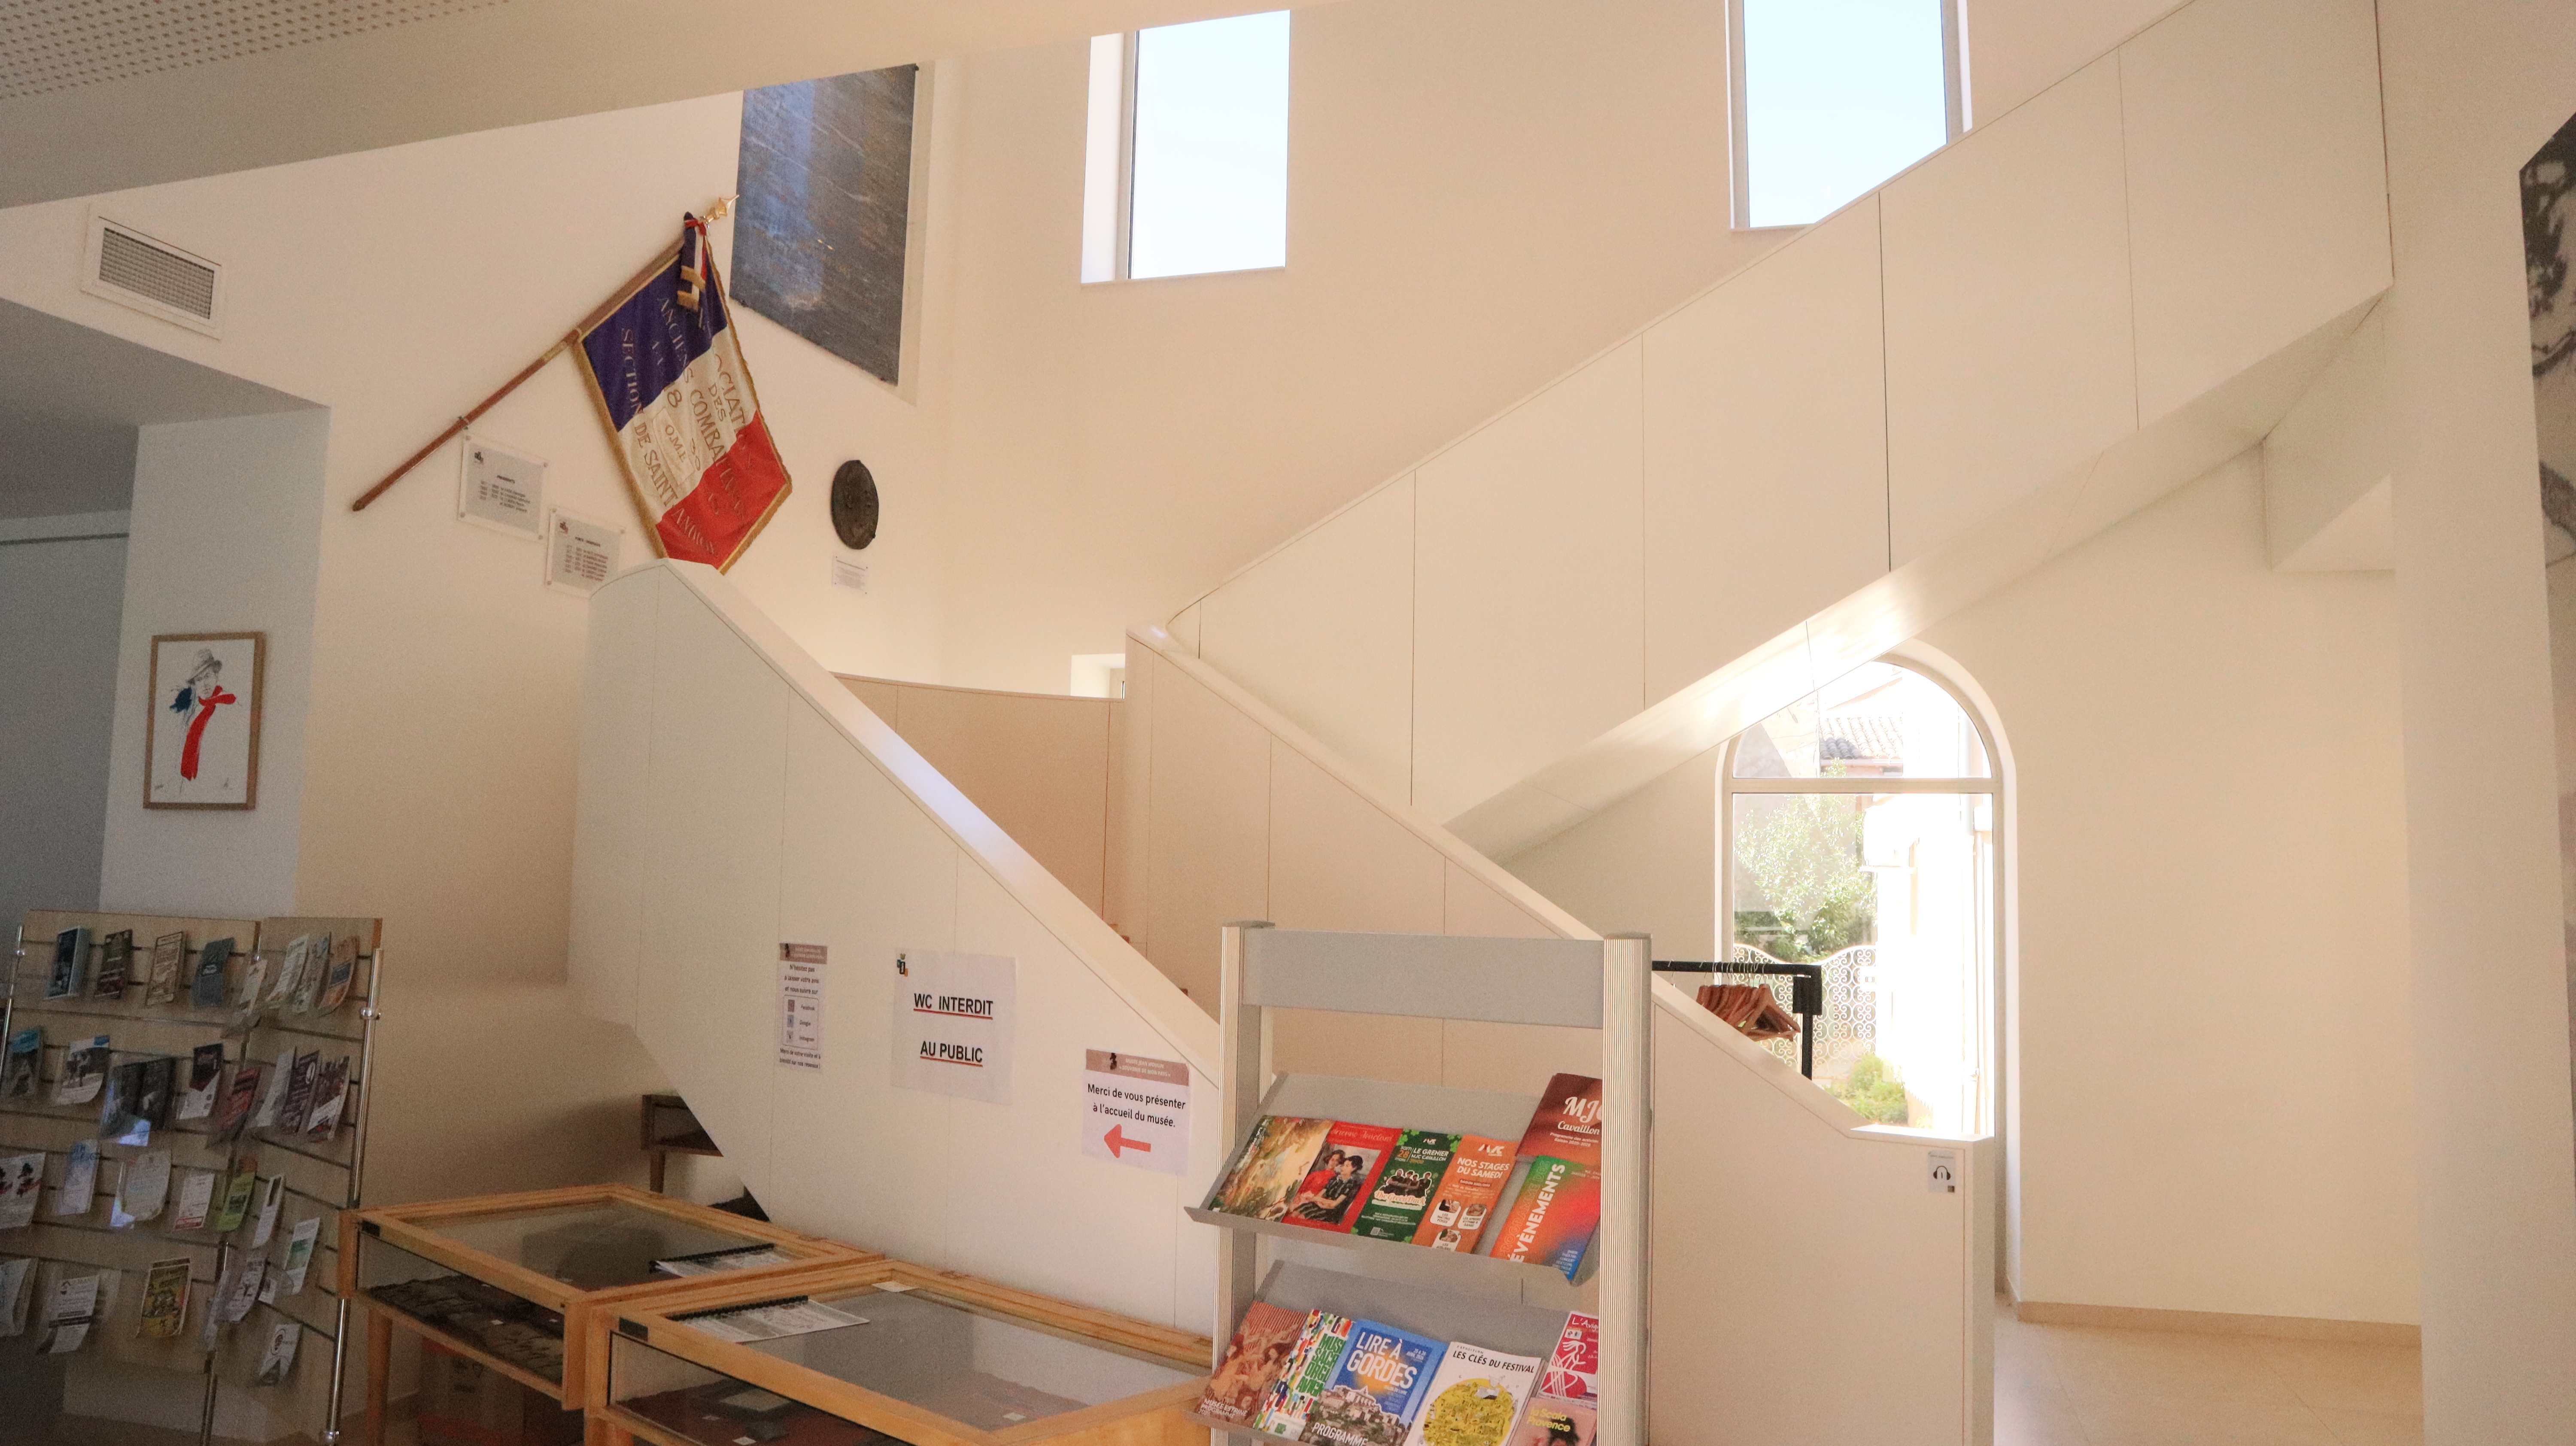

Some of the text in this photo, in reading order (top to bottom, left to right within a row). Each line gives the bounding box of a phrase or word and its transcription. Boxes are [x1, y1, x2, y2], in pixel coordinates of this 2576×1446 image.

[708, 383, 726, 421] DES
[634, 422, 651, 448] DE
[914, 993, 993, 1015] WC INTERDIT
[920, 1041, 983, 1063] AU PUBLIC
[1088, 1083, 1186, 1109] Merci de vous présenter
[1093, 1103, 1097, 1112] à
[1135, 1111, 1145, 1121] du
[1147, 1115, 1176, 1127] musée.
[1558, 1121, 1600, 1135] Cavaillon
[1397, 1150, 1410, 1158] 28
[1457, 1157, 1510, 1171] NOS STAGES
[1457, 1166, 1503, 1179] DU SAMEDI
[1507, 1164, 1566, 1263] ÉVÈNEMENTS
[1356, 1332, 1403, 1360] LIRE À
[1347, 1350, 1417, 1389] GORDES
[1453, 1350, 1534, 1373] LES CLÉS DU FESTIVAL
[1200, 1403, 1236, 1419] PROGRAMME
[1224, 1405, 1248, 1416] ESTRINE
[1540, 1408, 1567, 1422] Scala
[1312, 1422, 1368, 1446] PROGRAMME
[1527, 1416, 1571, 1432] Provence
